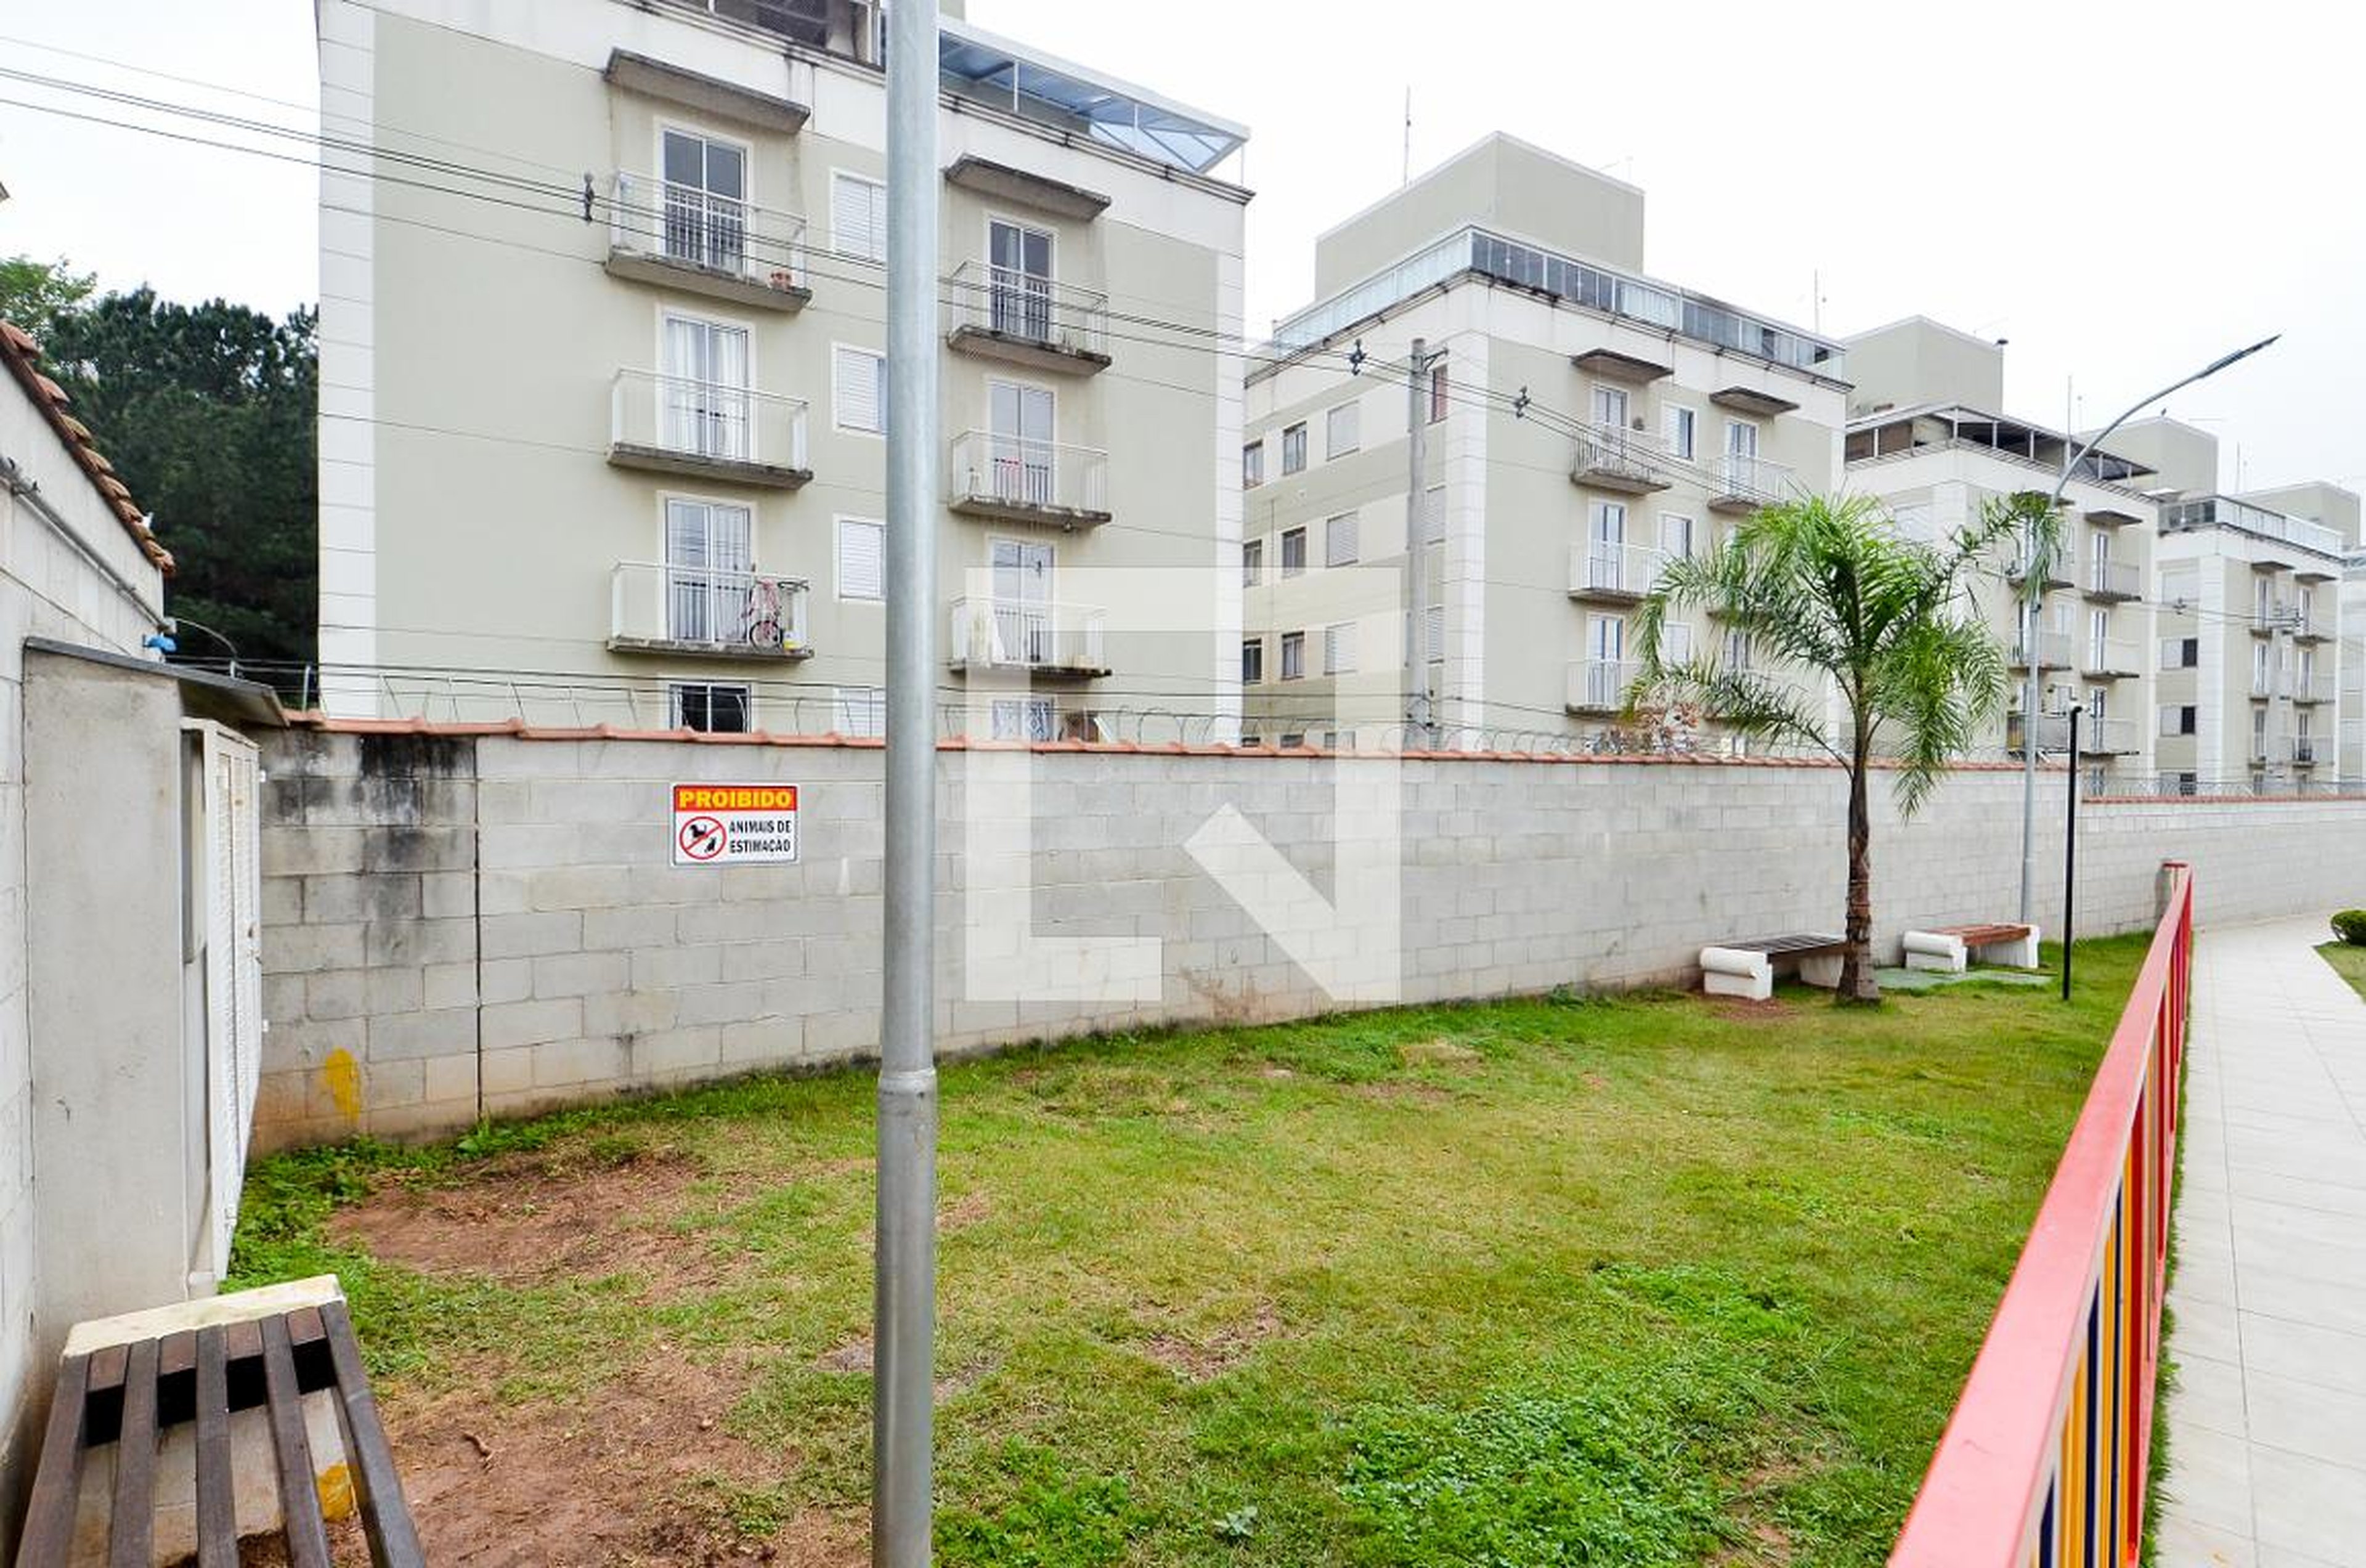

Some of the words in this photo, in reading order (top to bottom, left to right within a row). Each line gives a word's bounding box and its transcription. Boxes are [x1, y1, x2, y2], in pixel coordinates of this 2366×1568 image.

[679, 790, 791, 808] PROIBIDO
[730, 820, 774, 833] ANIMAIS
[777, 820, 791, 833] DE
